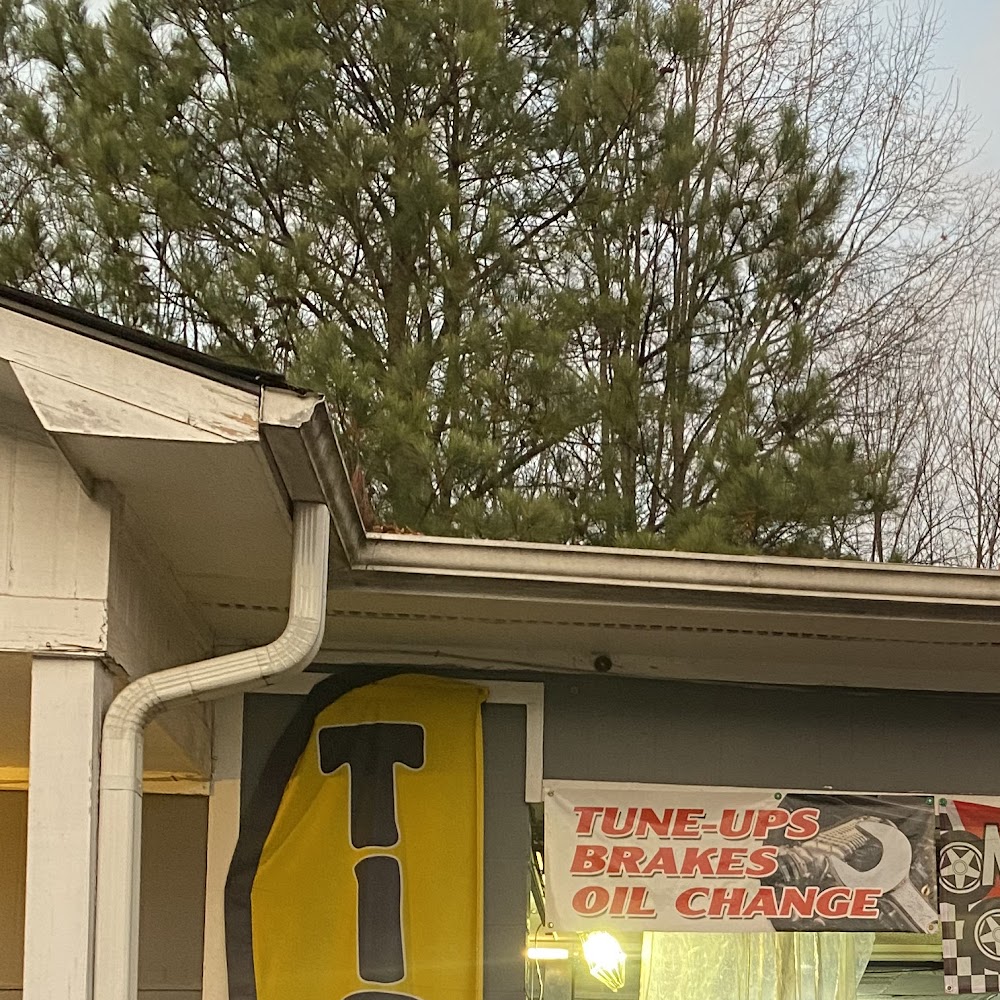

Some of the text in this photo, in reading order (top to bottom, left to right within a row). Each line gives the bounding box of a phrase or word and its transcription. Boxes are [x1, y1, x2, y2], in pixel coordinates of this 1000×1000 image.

[572, 806, 820, 841] TUNE-UPS
[569, 844, 779, 878] BRAKES
[571, 885, 883, 920] OIL CHANGE
